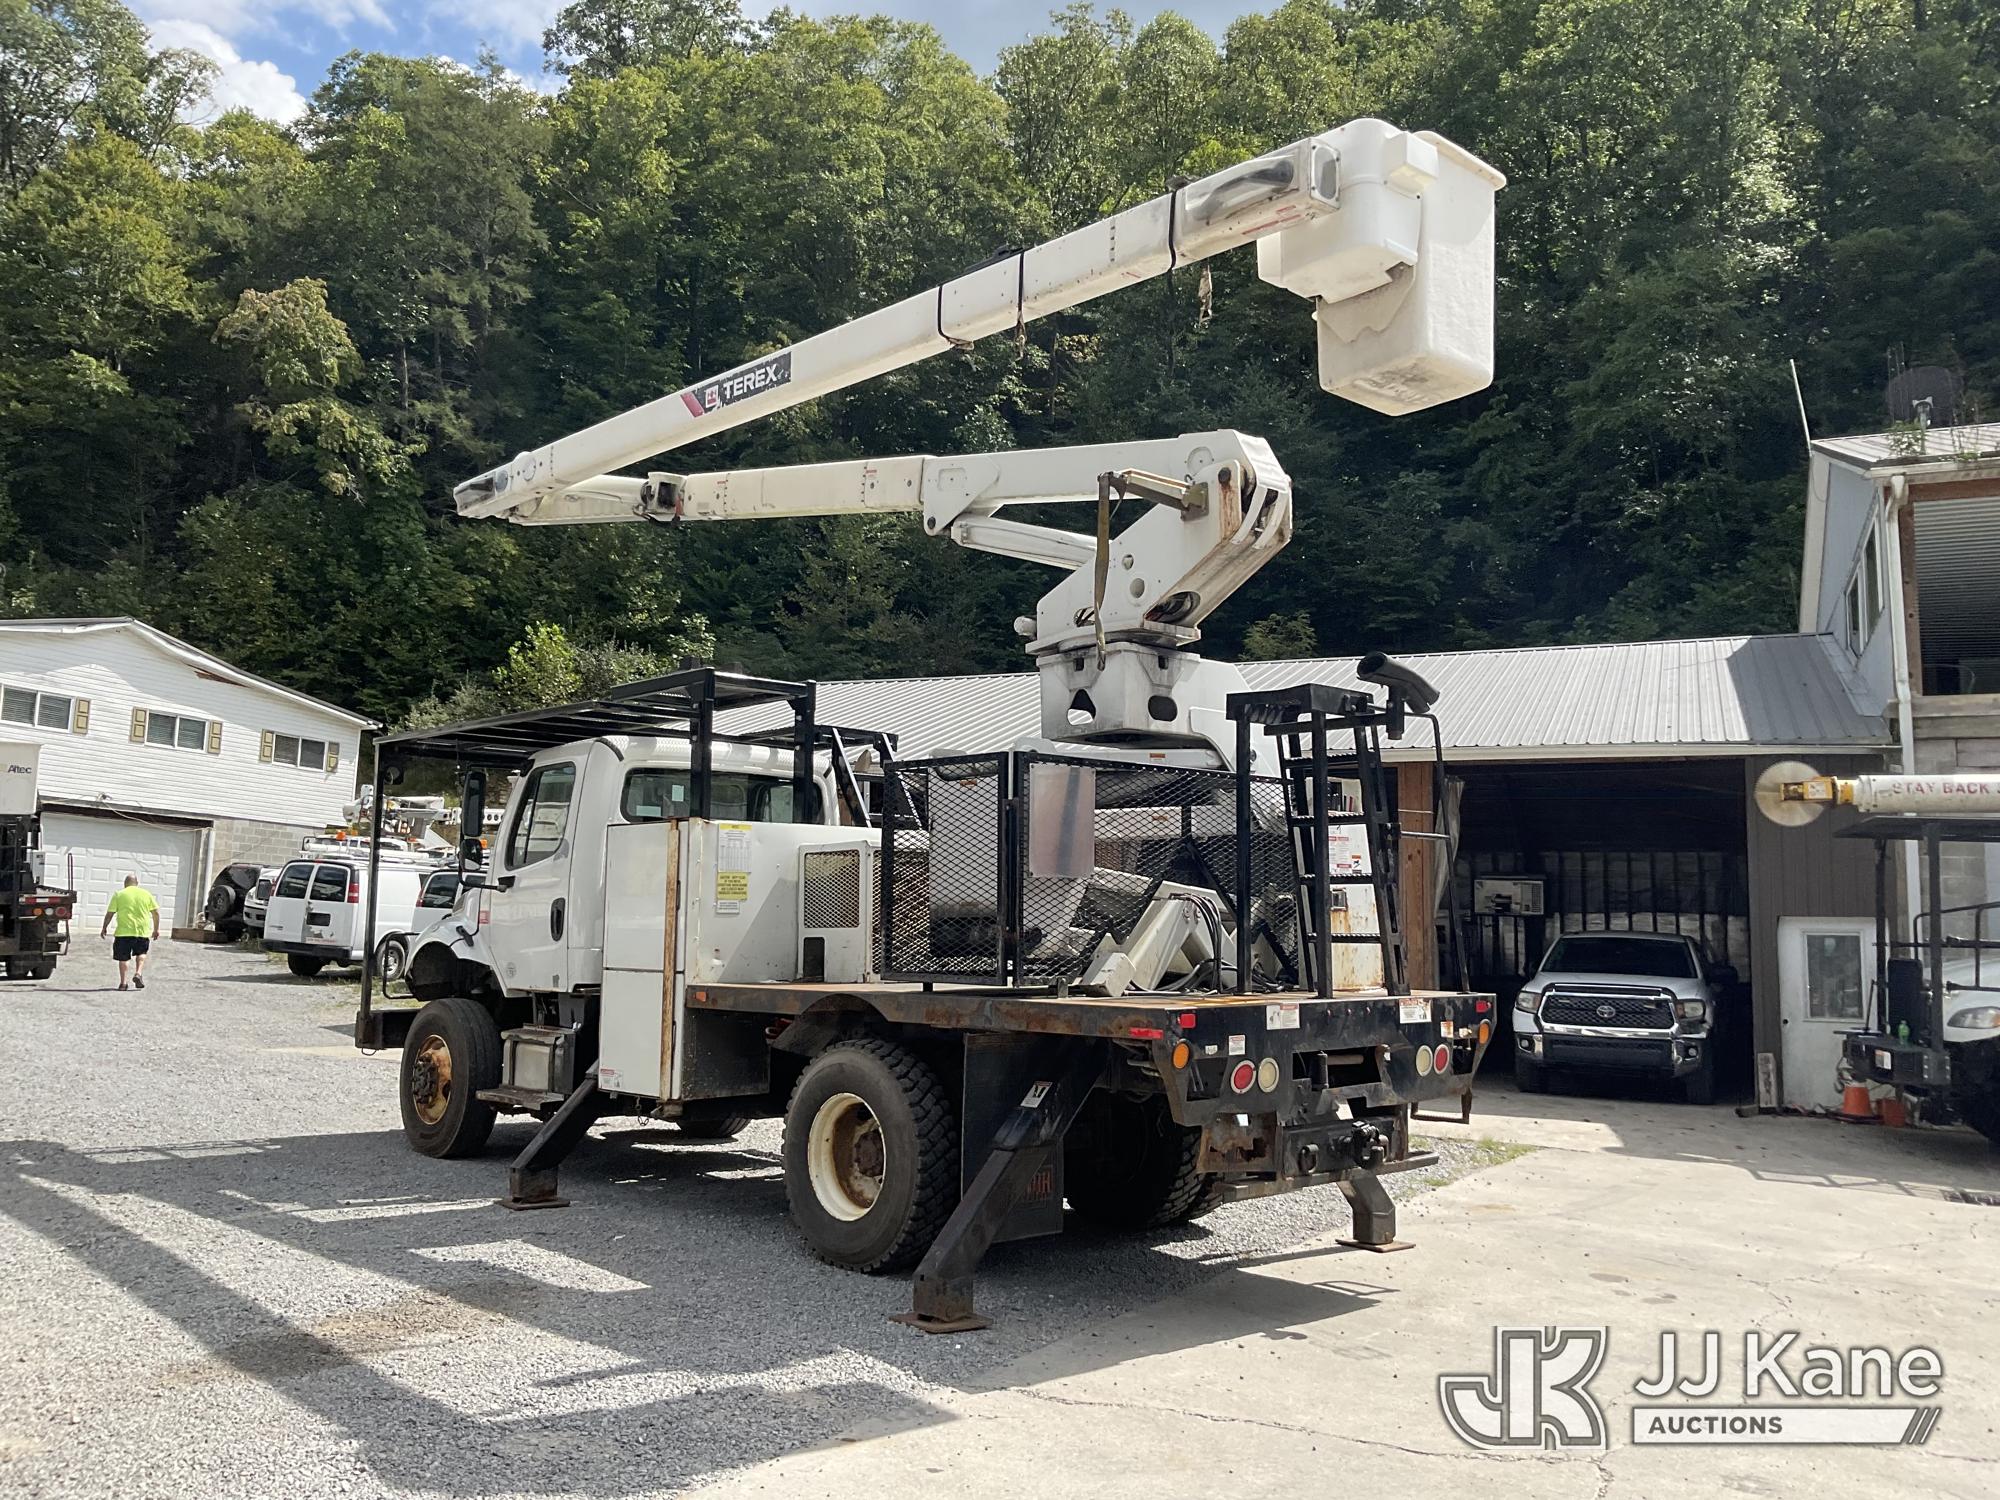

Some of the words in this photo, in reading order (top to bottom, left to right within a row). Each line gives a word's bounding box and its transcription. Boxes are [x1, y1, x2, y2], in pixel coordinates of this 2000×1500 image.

[722, 363, 778, 399] TEREX
[1892, 782, 1936, 795] STAY
[1942, 782, 1990, 795] BACK
